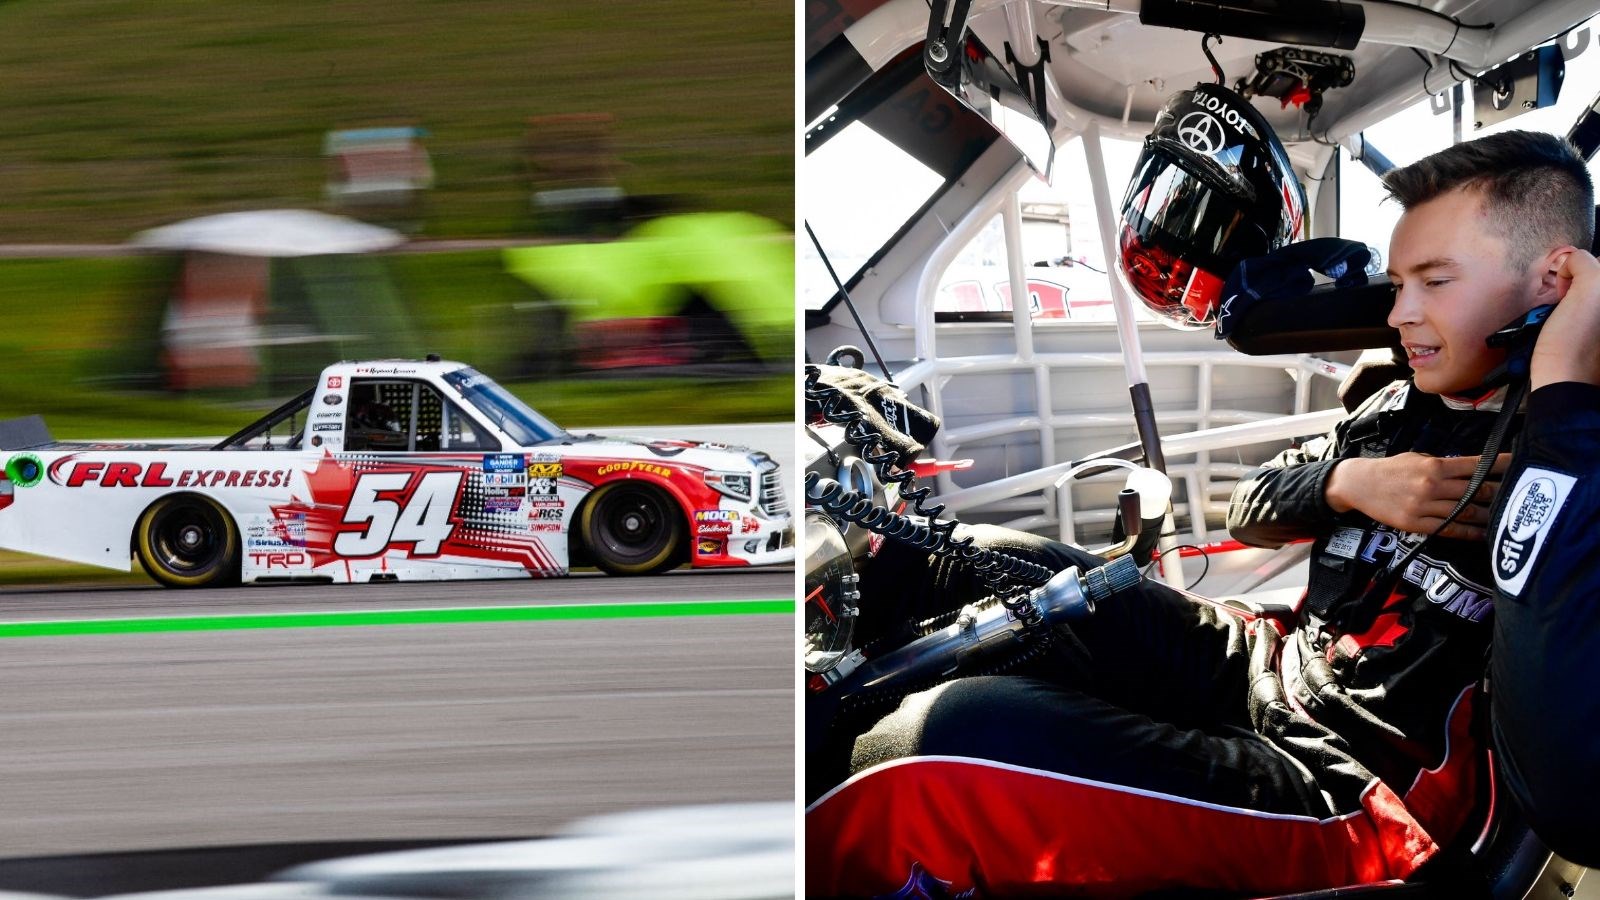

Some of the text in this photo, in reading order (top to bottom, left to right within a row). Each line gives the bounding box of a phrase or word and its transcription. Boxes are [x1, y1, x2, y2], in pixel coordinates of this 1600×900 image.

[1192, 91, 1247, 135] TOYOTA
[66, 462, 174, 487] FRL
[176, 468, 293, 488] EXPRESS!
[597, 461, 672, 478] GOODYEAR
[485, 474, 514, 484] Mobil
[528, 477, 557, 494] K&N
[484, 487, 509, 498] Holley
[333, 471, 464, 557] 54
[695, 510, 738, 521] MOOG
[1511, 482, 1542, 534] MANUFACTURER
[1522, 492, 1546, 527] CERTIFIED
[530, 523, 561, 532] SIMPSON
[248, 553, 305, 569] TRD
[1500, 539, 1524, 574] sfi
